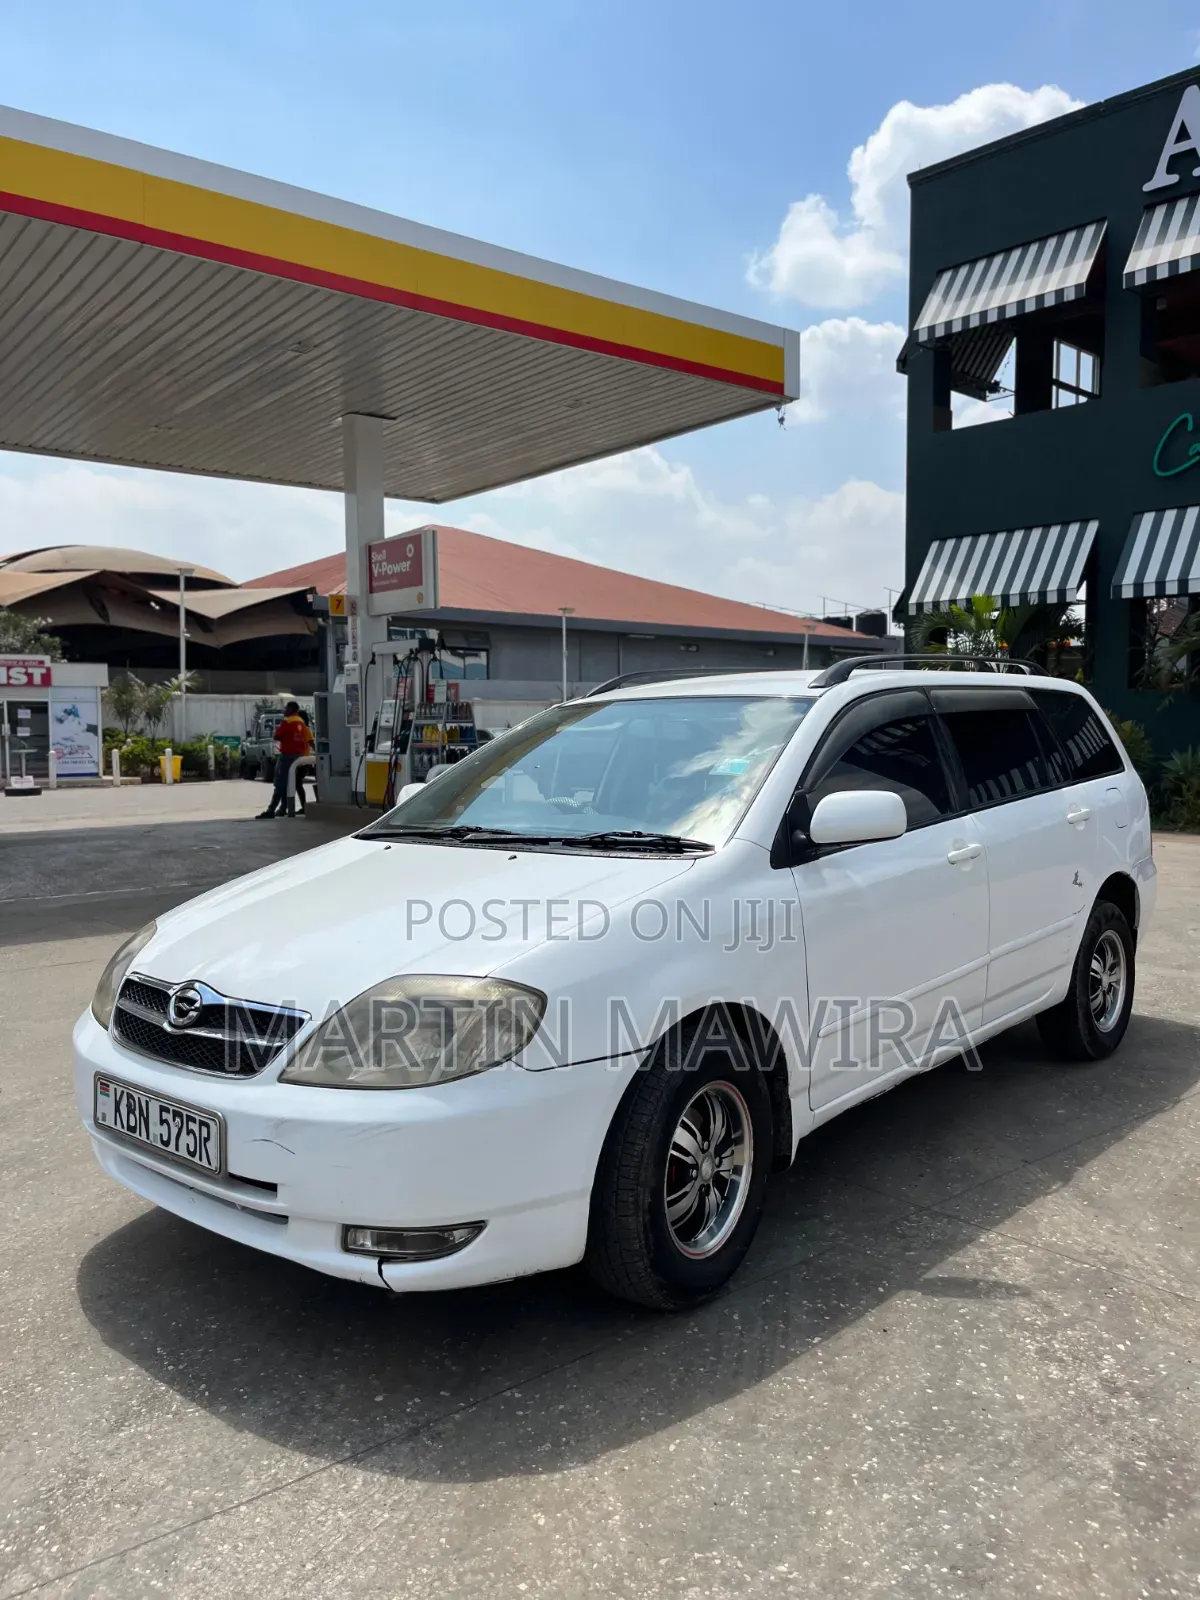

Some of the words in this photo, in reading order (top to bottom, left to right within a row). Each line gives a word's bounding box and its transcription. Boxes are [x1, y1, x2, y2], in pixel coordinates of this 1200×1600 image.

[371, 549, 386, 562] Shell
[371, 560, 412, 577] V-Power
[335, 599, 343, 610] 7
[113, 1087, 150, 1141] KBN
[158, 1103, 212, 1167] 575R
